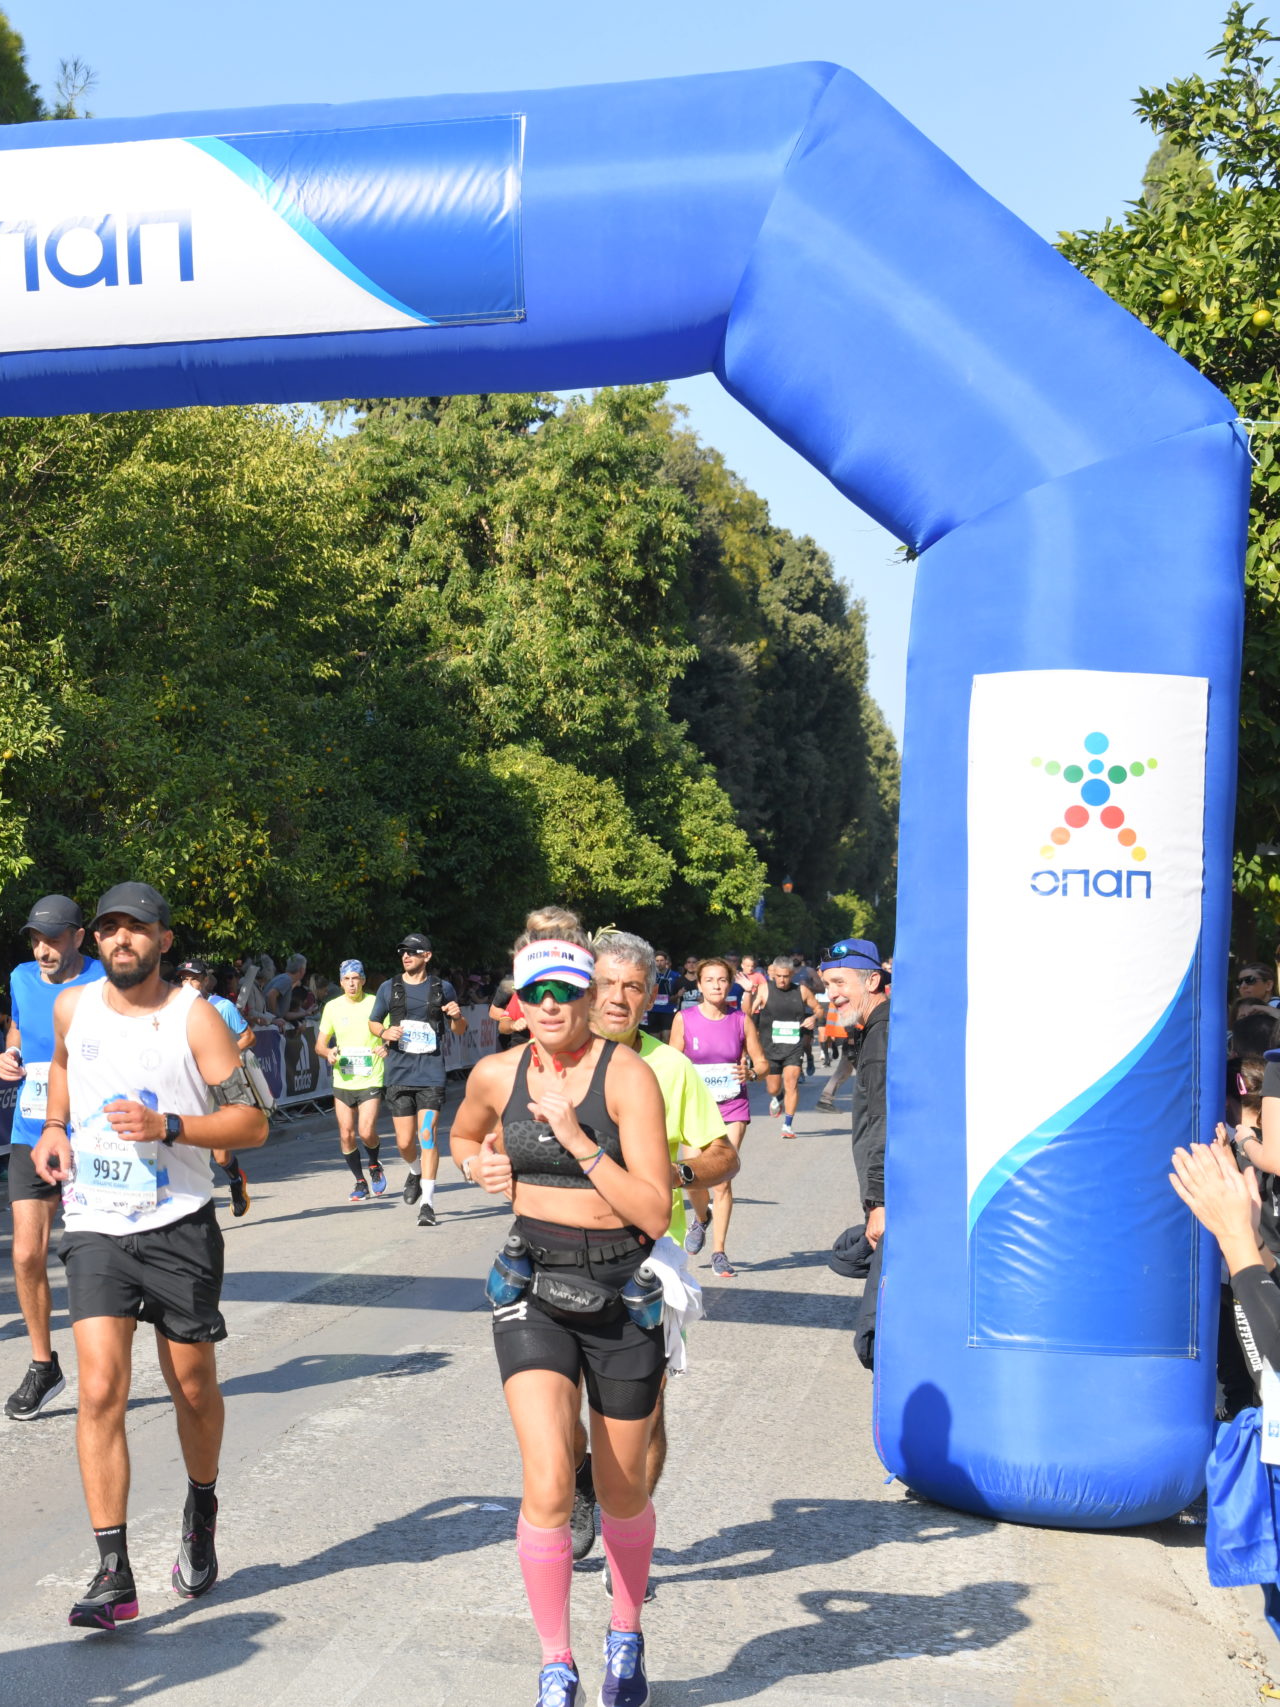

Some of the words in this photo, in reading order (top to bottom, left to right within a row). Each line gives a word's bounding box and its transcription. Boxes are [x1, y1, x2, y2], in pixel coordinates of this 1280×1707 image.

[93, 1158, 133, 1182] 9937
[549, 1288, 590, 1306] NATHAN
[1234, 1304, 1264, 1373] GRYFFINDOR
